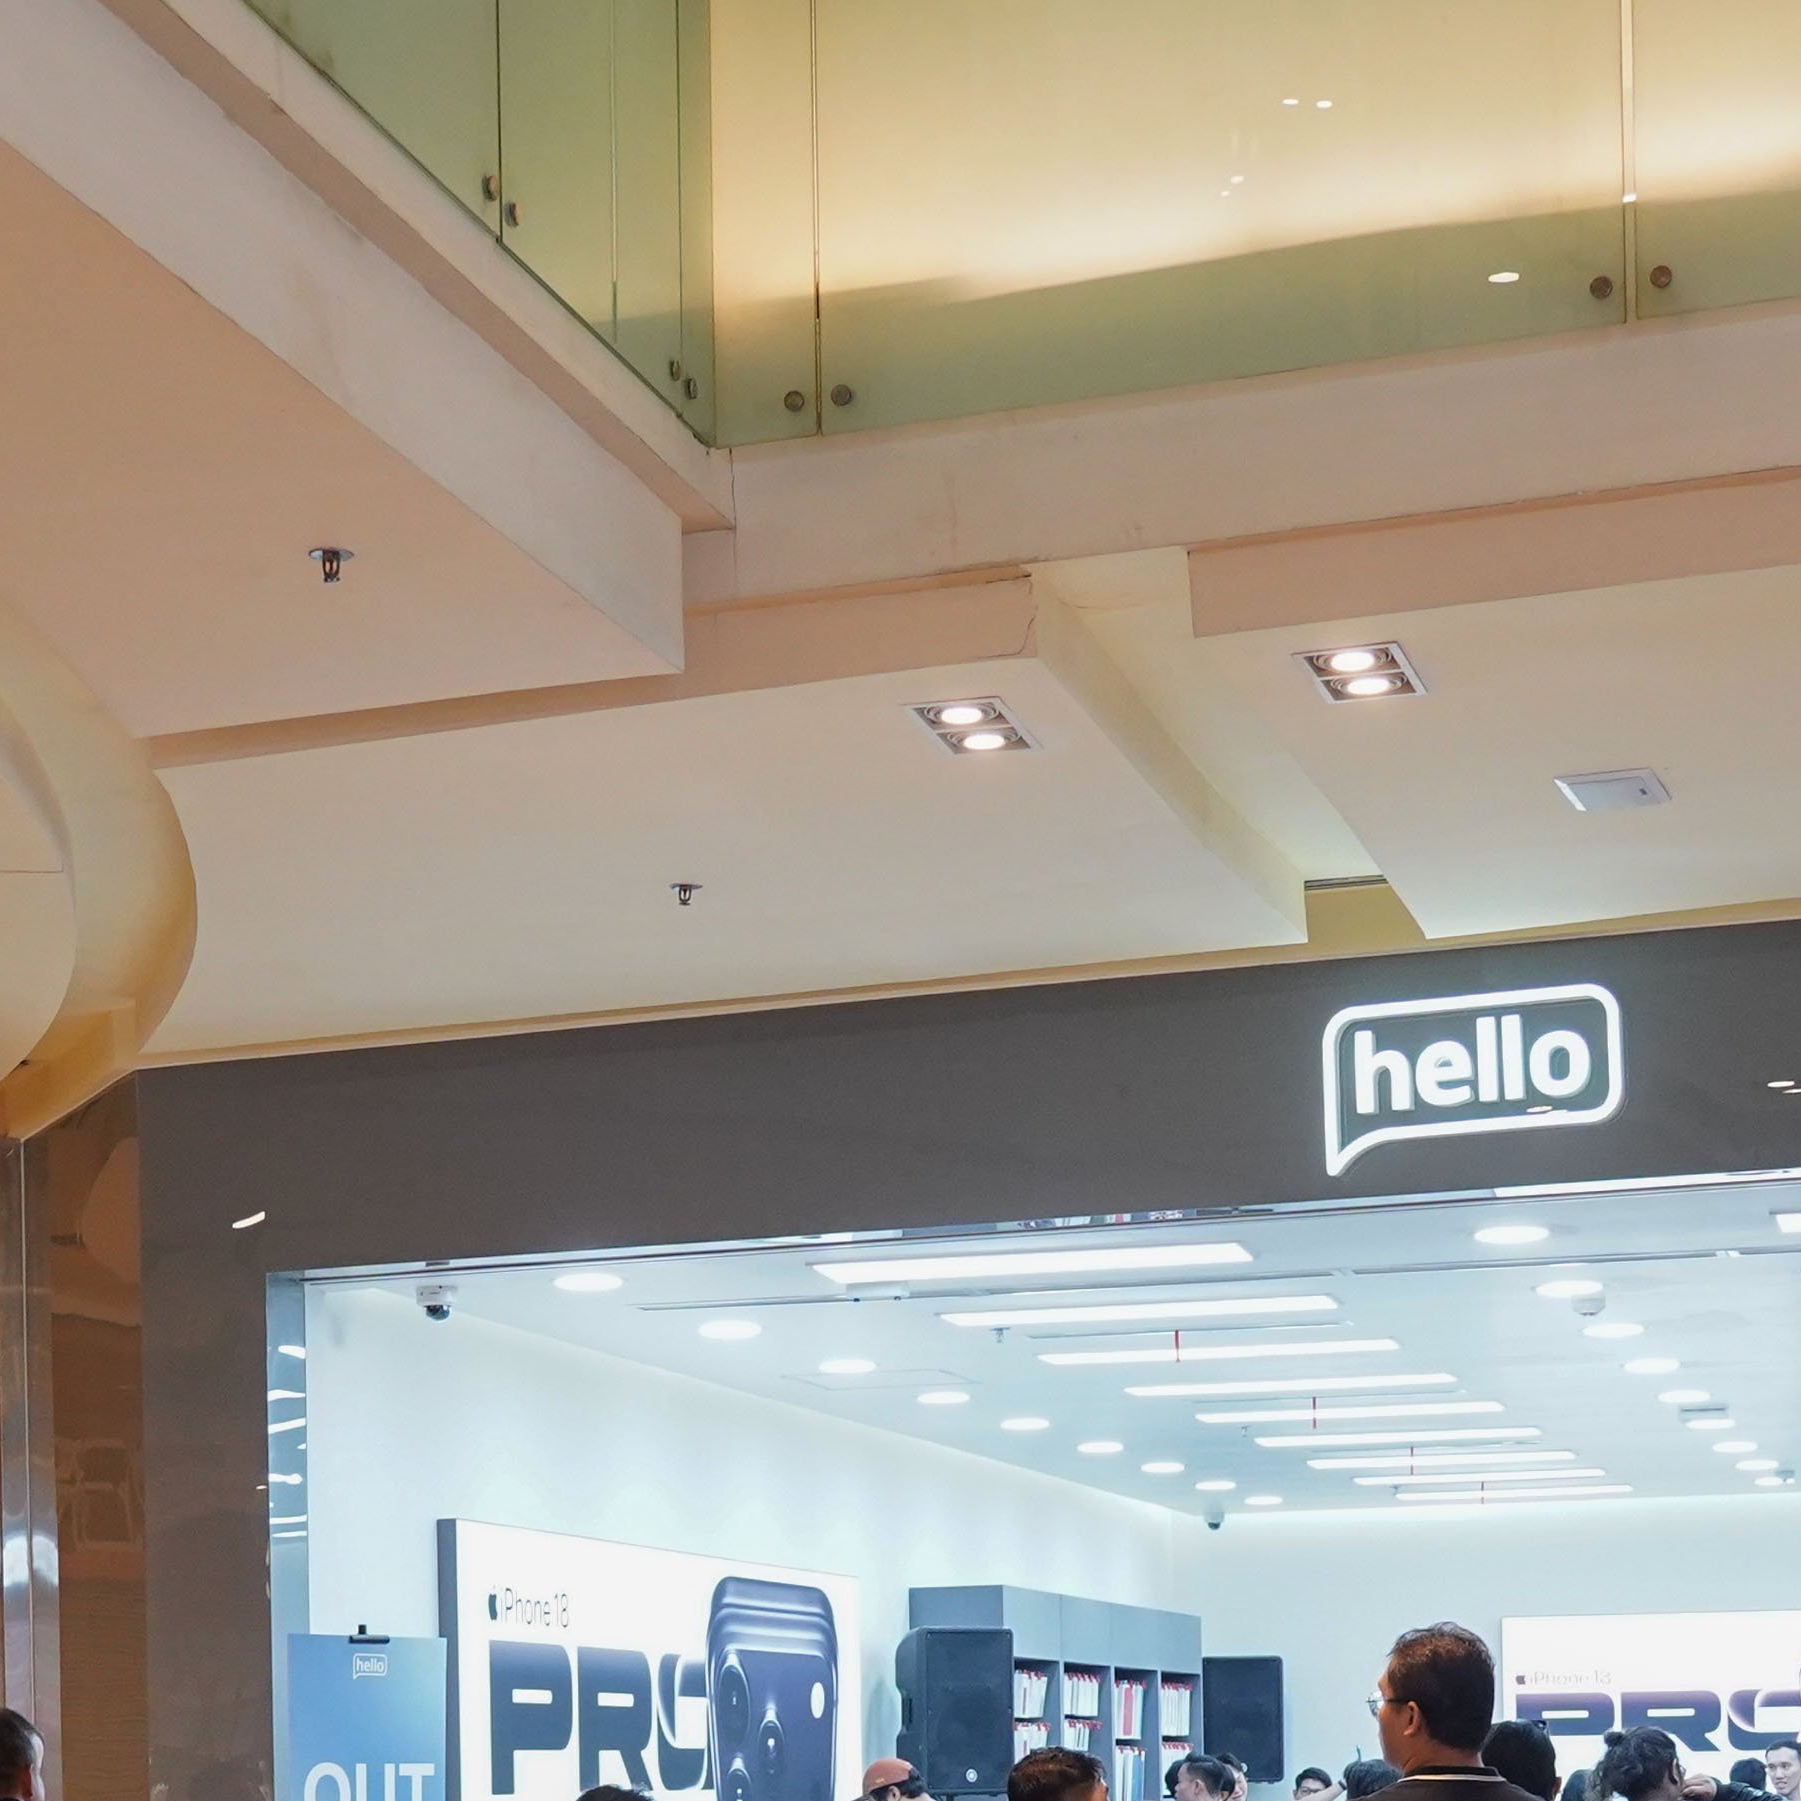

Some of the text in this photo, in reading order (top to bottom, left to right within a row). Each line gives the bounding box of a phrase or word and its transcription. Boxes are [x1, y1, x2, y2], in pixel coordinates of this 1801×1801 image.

[1354, 1014, 1592, 1114] hello
[500, 1587, 570, 1628] iPhone 18
[356, 1658, 385, 1673] hello
